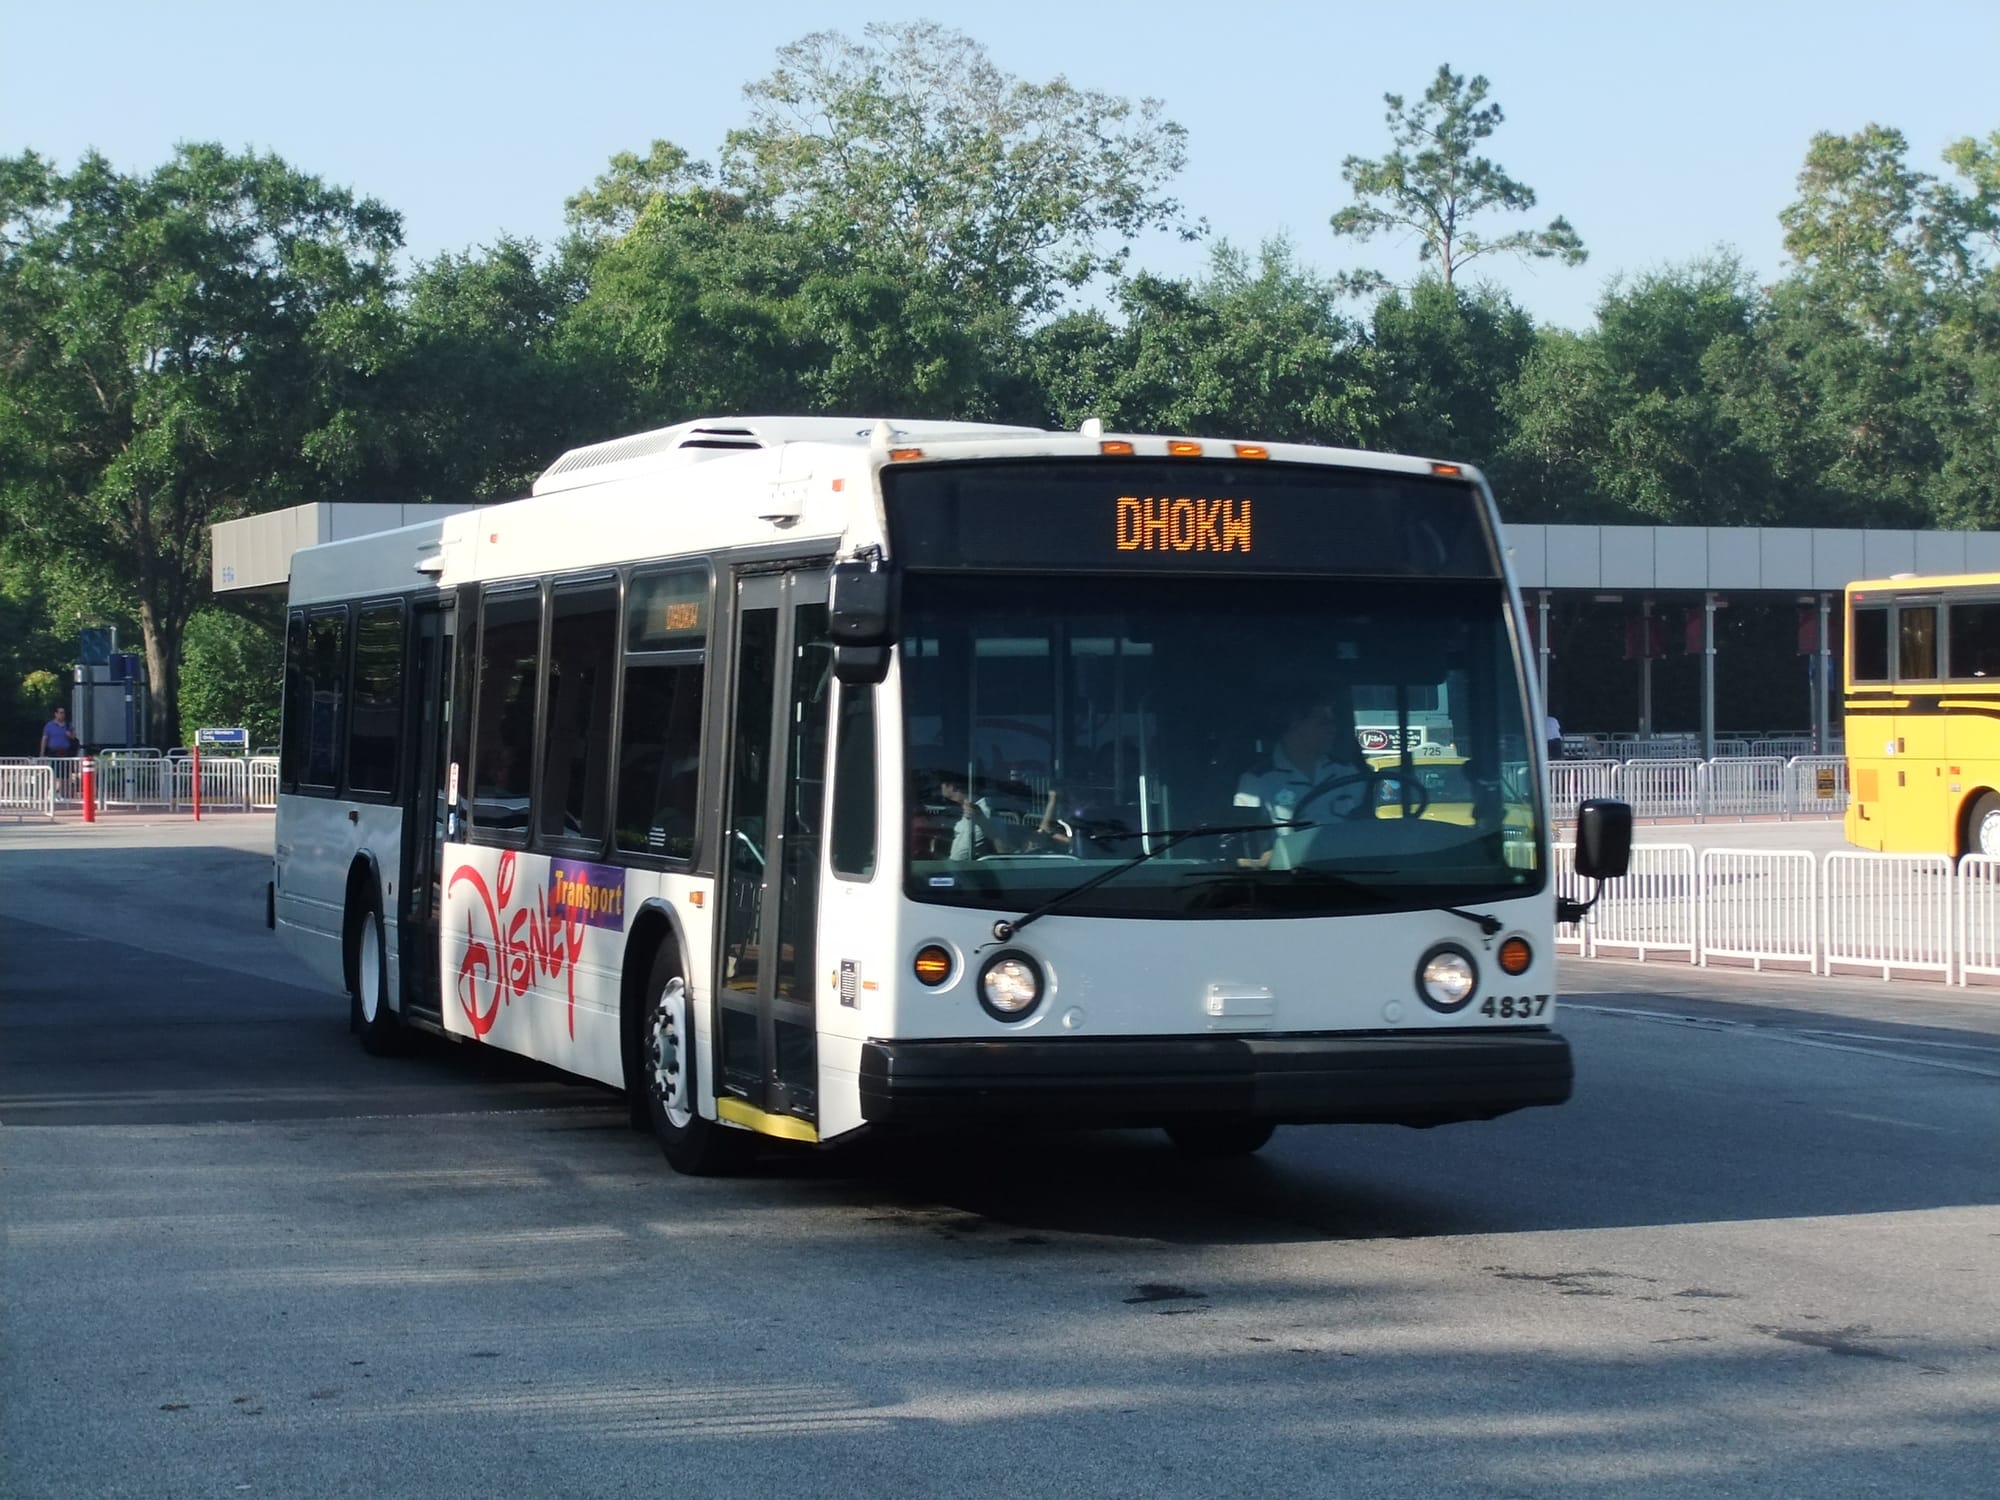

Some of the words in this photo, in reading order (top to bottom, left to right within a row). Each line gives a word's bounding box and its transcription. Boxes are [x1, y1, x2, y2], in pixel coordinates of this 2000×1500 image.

[1422, 747, 1441, 756] 725
[555, 869, 623, 919] Transport
[1480, 994, 1551, 1019] 4837
